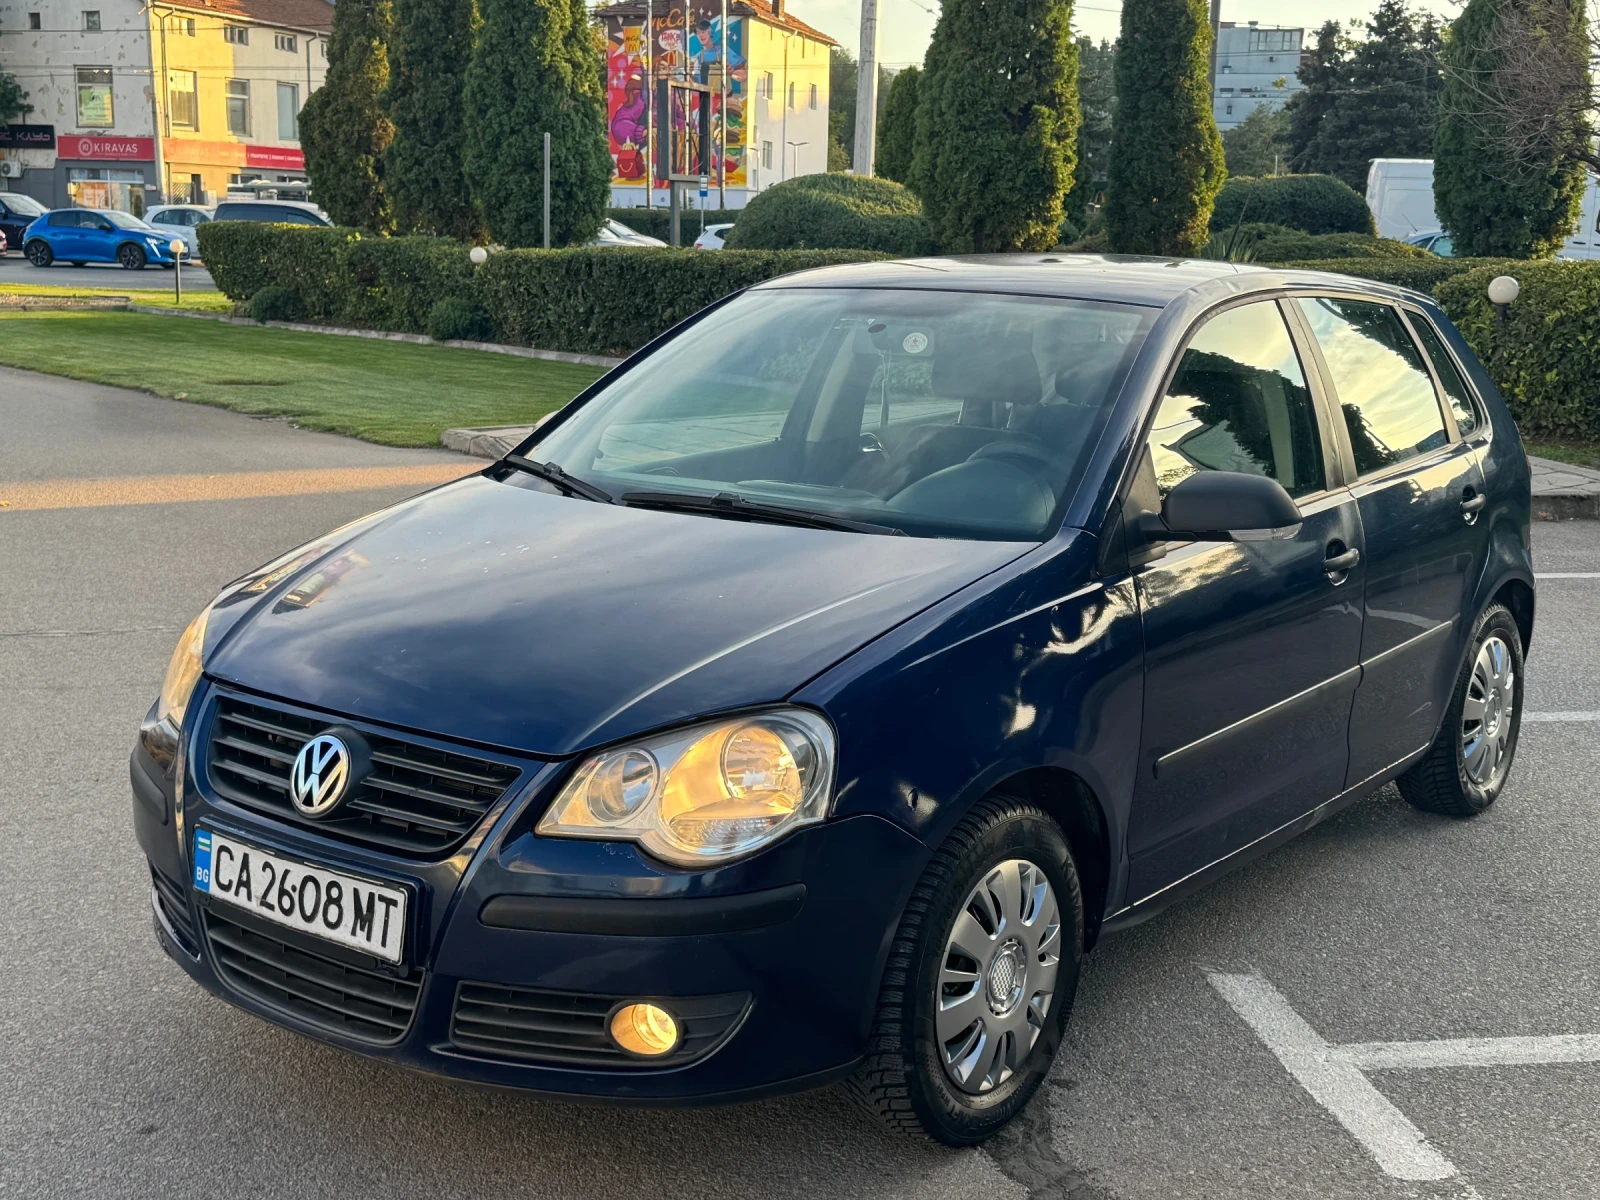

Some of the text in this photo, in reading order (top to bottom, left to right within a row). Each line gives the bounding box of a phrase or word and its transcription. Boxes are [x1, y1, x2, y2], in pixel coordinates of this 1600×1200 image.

[94, 142, 138, 153] KIRAVAS
[196, 867, 209, 883] BG
[259, 860, 344, 930] 2608
[351, 887, 398, 948] MT
